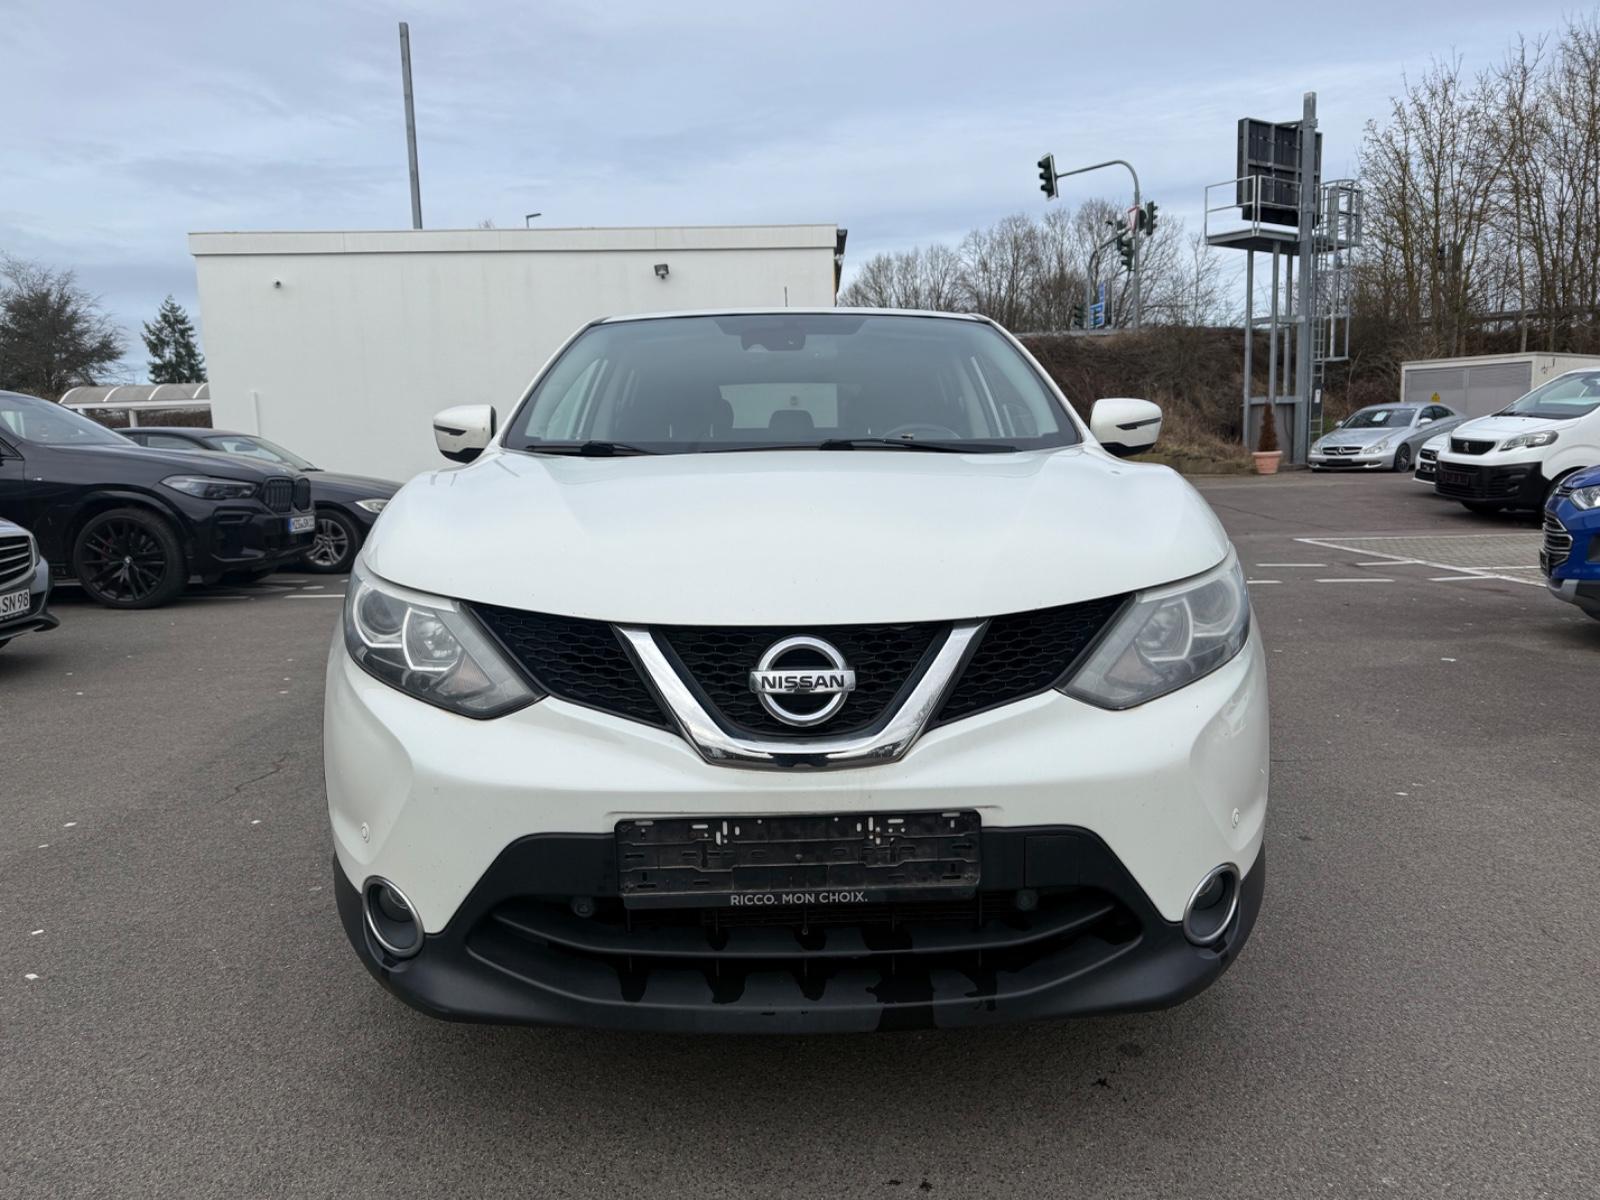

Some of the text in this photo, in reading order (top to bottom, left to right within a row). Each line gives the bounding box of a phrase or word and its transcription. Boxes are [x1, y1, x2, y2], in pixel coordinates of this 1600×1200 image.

[17, 591, 29, 609] 98
[761, 674, 845, 689] NISSAN
[730, 891, 868, 906] RICCO. MON CHOIX.
